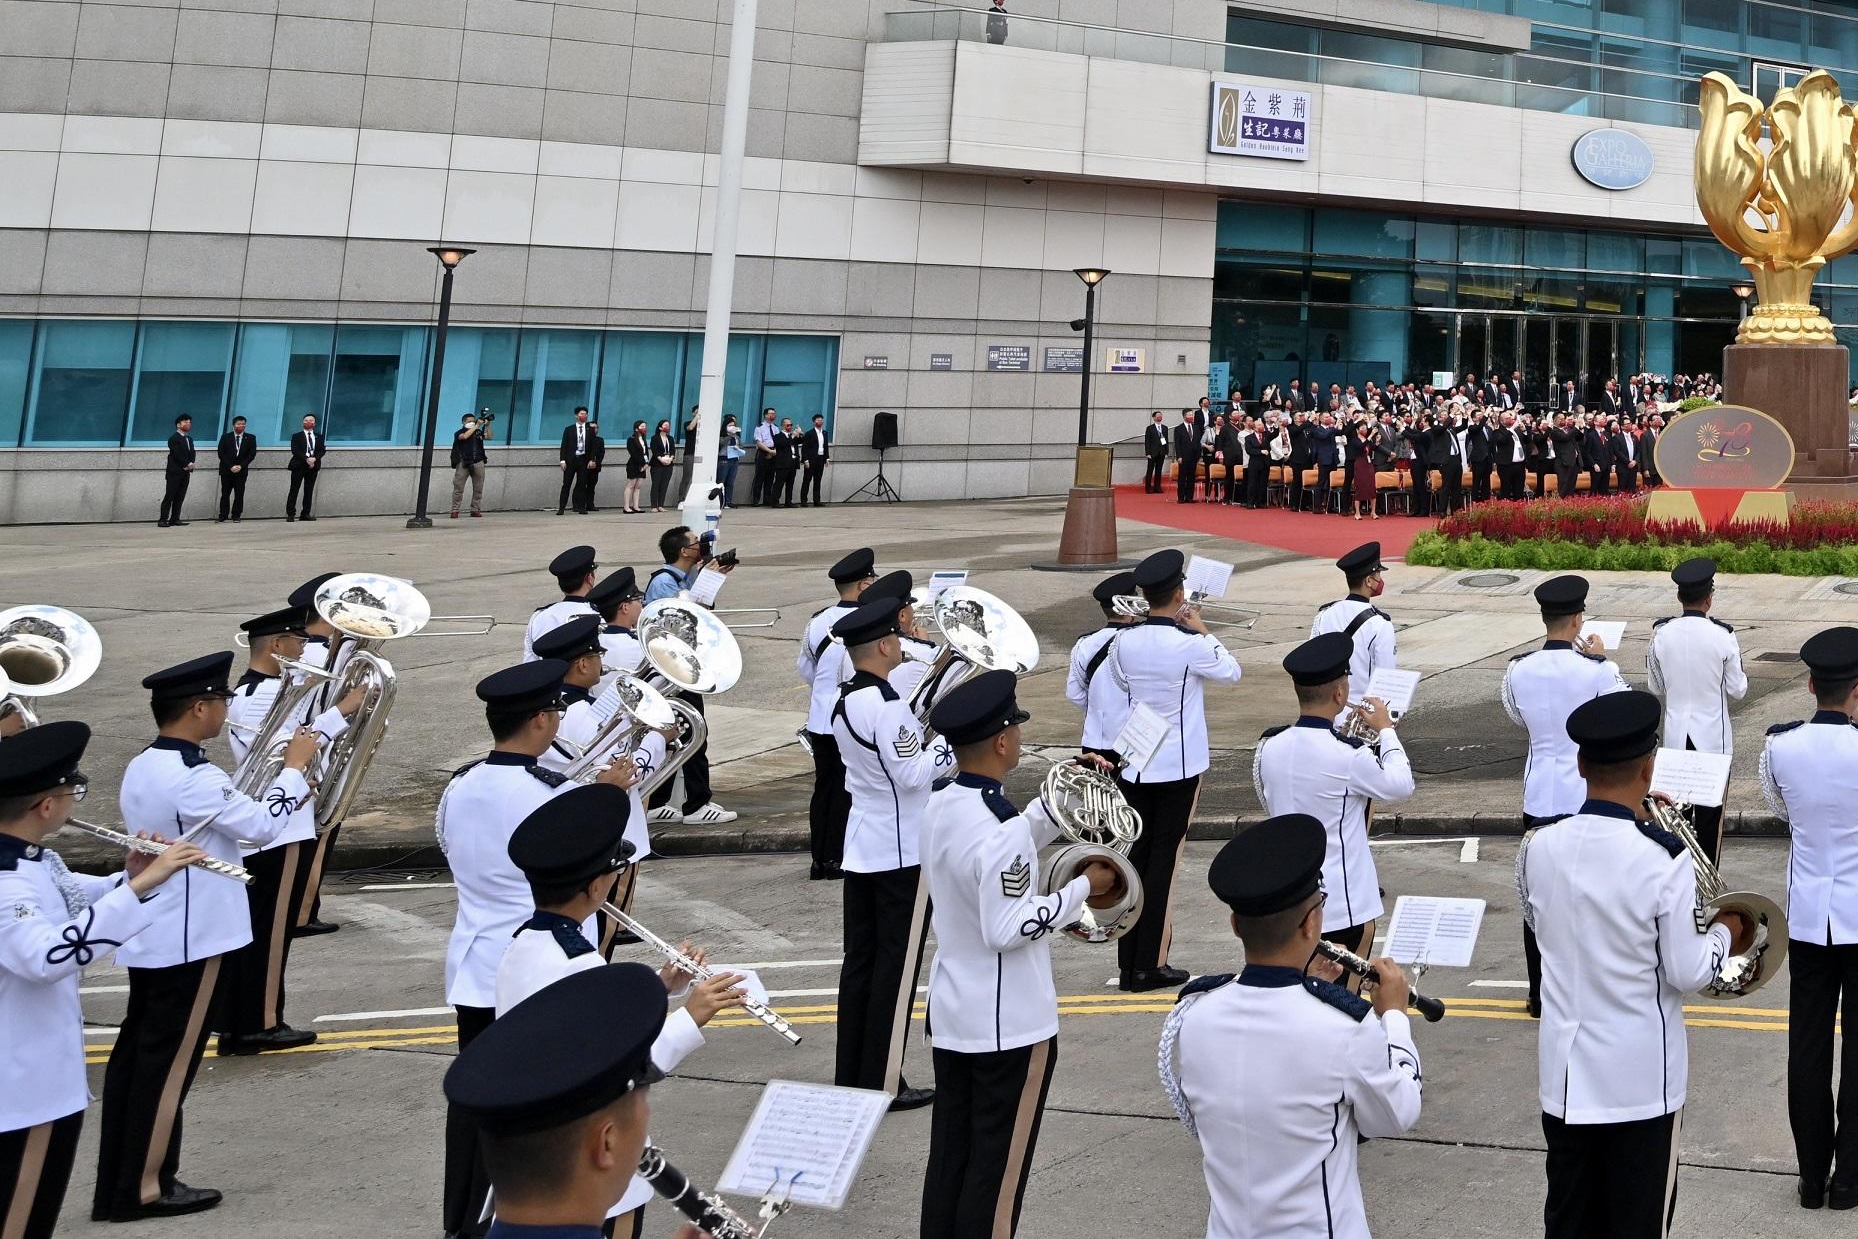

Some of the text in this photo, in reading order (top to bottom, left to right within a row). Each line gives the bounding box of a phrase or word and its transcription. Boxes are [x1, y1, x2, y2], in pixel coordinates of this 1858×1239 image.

[1242, 90, 1306, 119] 金紫荊
[1240, 141, 1257, 149] Golden
[1588, 137, 1627, 156] EXPO
